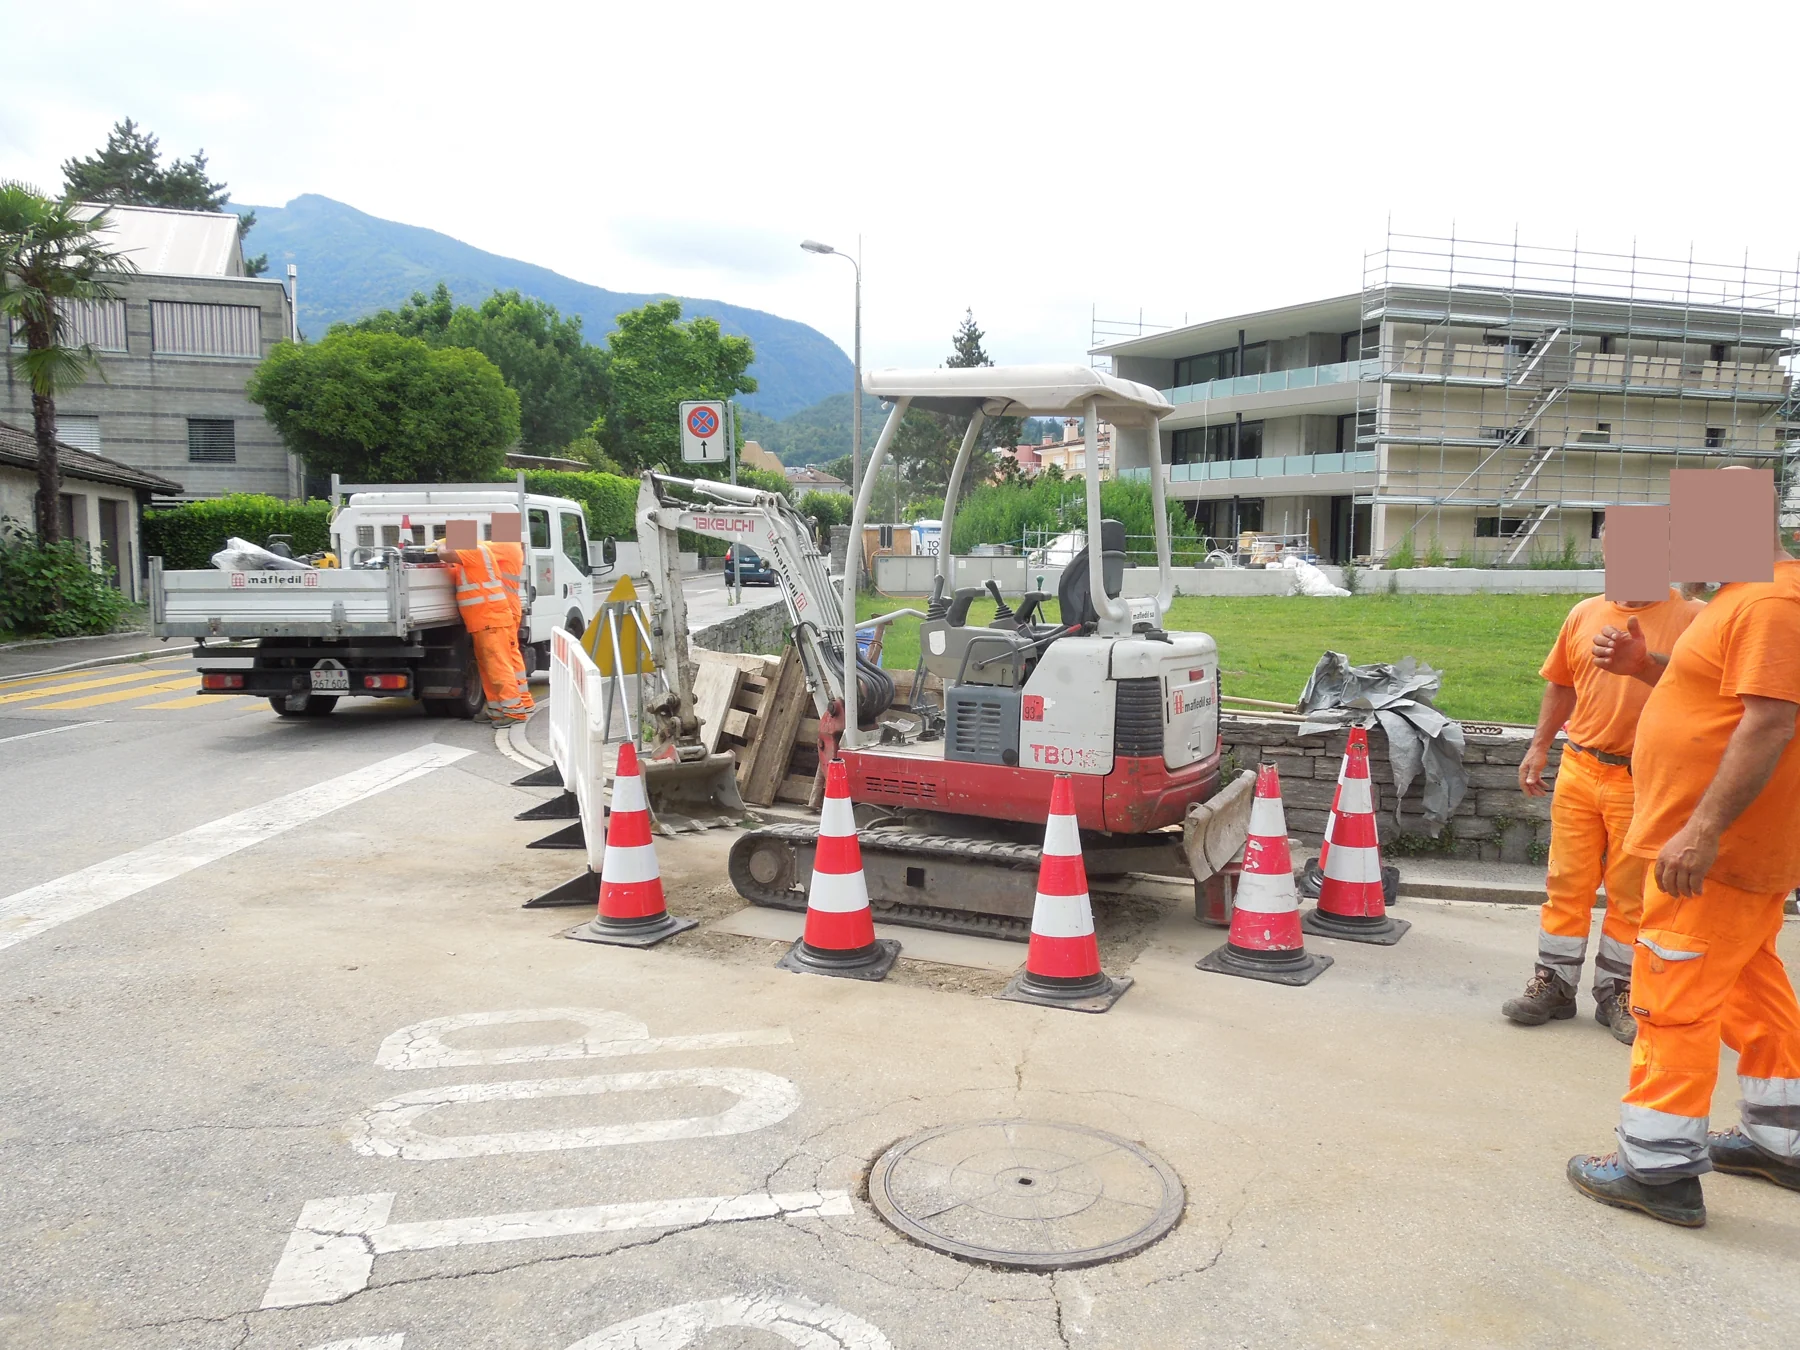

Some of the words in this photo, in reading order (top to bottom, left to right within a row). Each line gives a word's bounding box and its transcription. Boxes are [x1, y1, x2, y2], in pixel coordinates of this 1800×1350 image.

[693, 517, 754, 532] TAKEUCHI
[927, 540, 940, 548] TO
[927, 548, 940, 556] TO
[1024, 706, 1036, 720] 93
